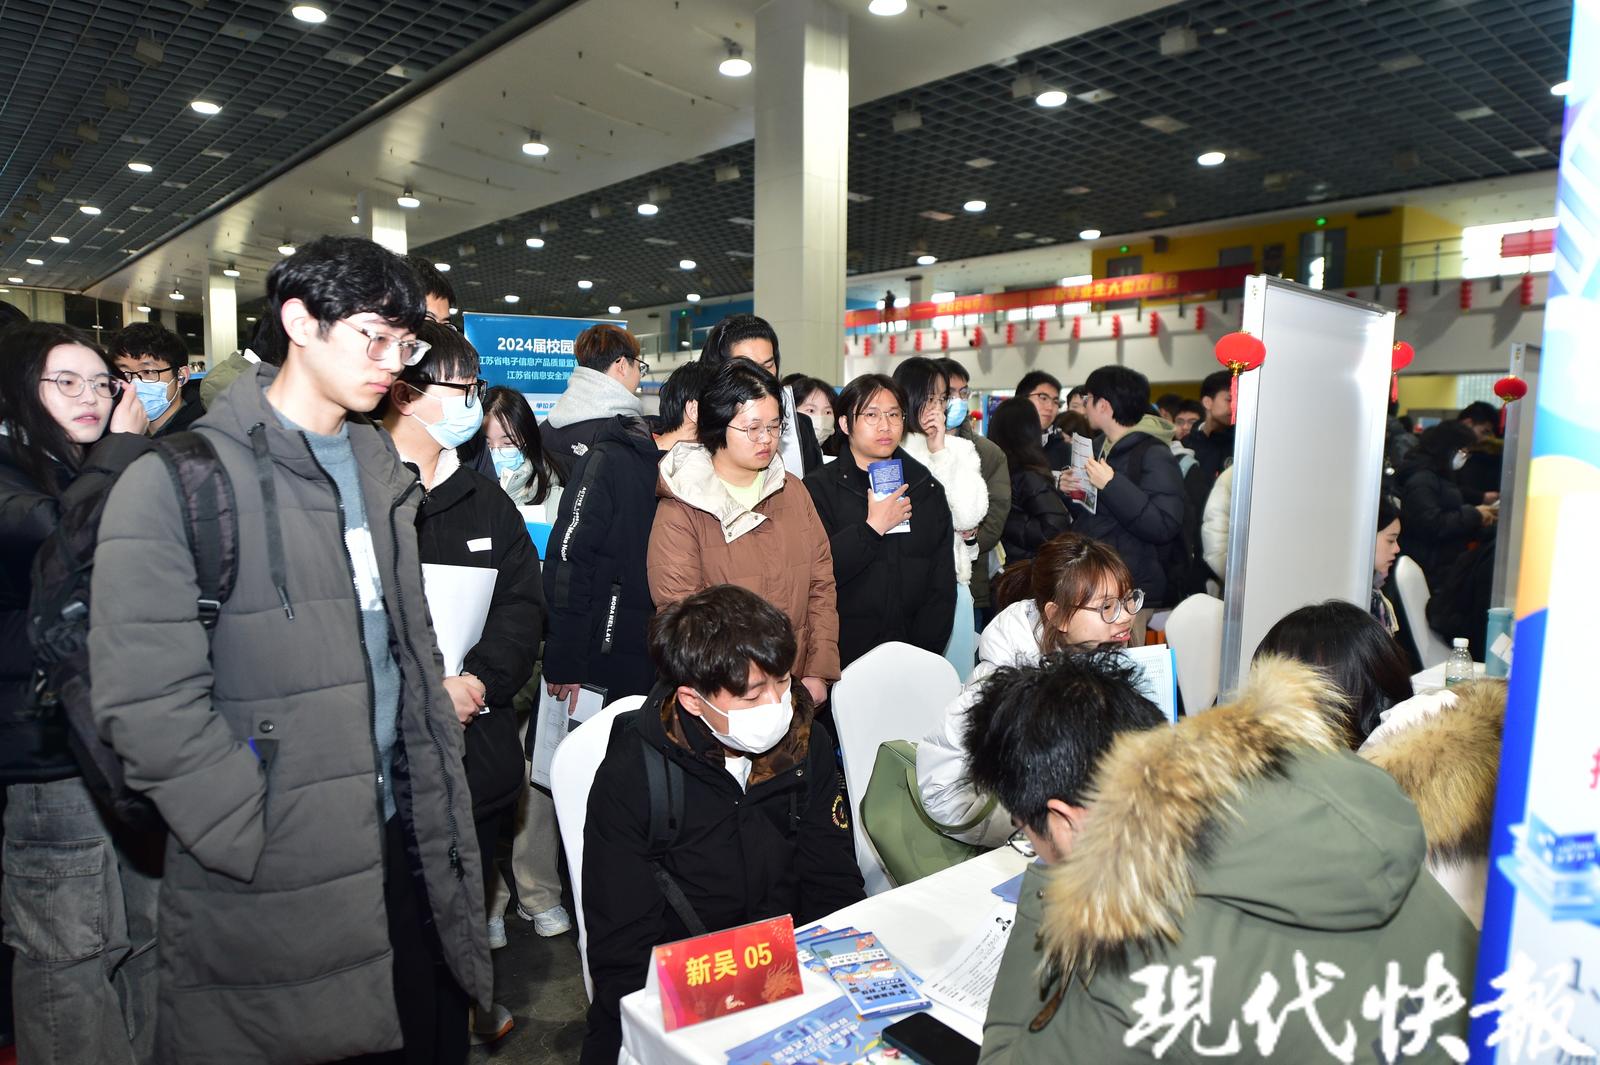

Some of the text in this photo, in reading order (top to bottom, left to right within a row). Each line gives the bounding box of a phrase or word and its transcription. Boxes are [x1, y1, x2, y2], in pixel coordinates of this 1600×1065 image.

[497, 337, 575, 355] 2024届校园
[685, 948, 739, 987] 新吴
[744, 942, 773, 969] 05
